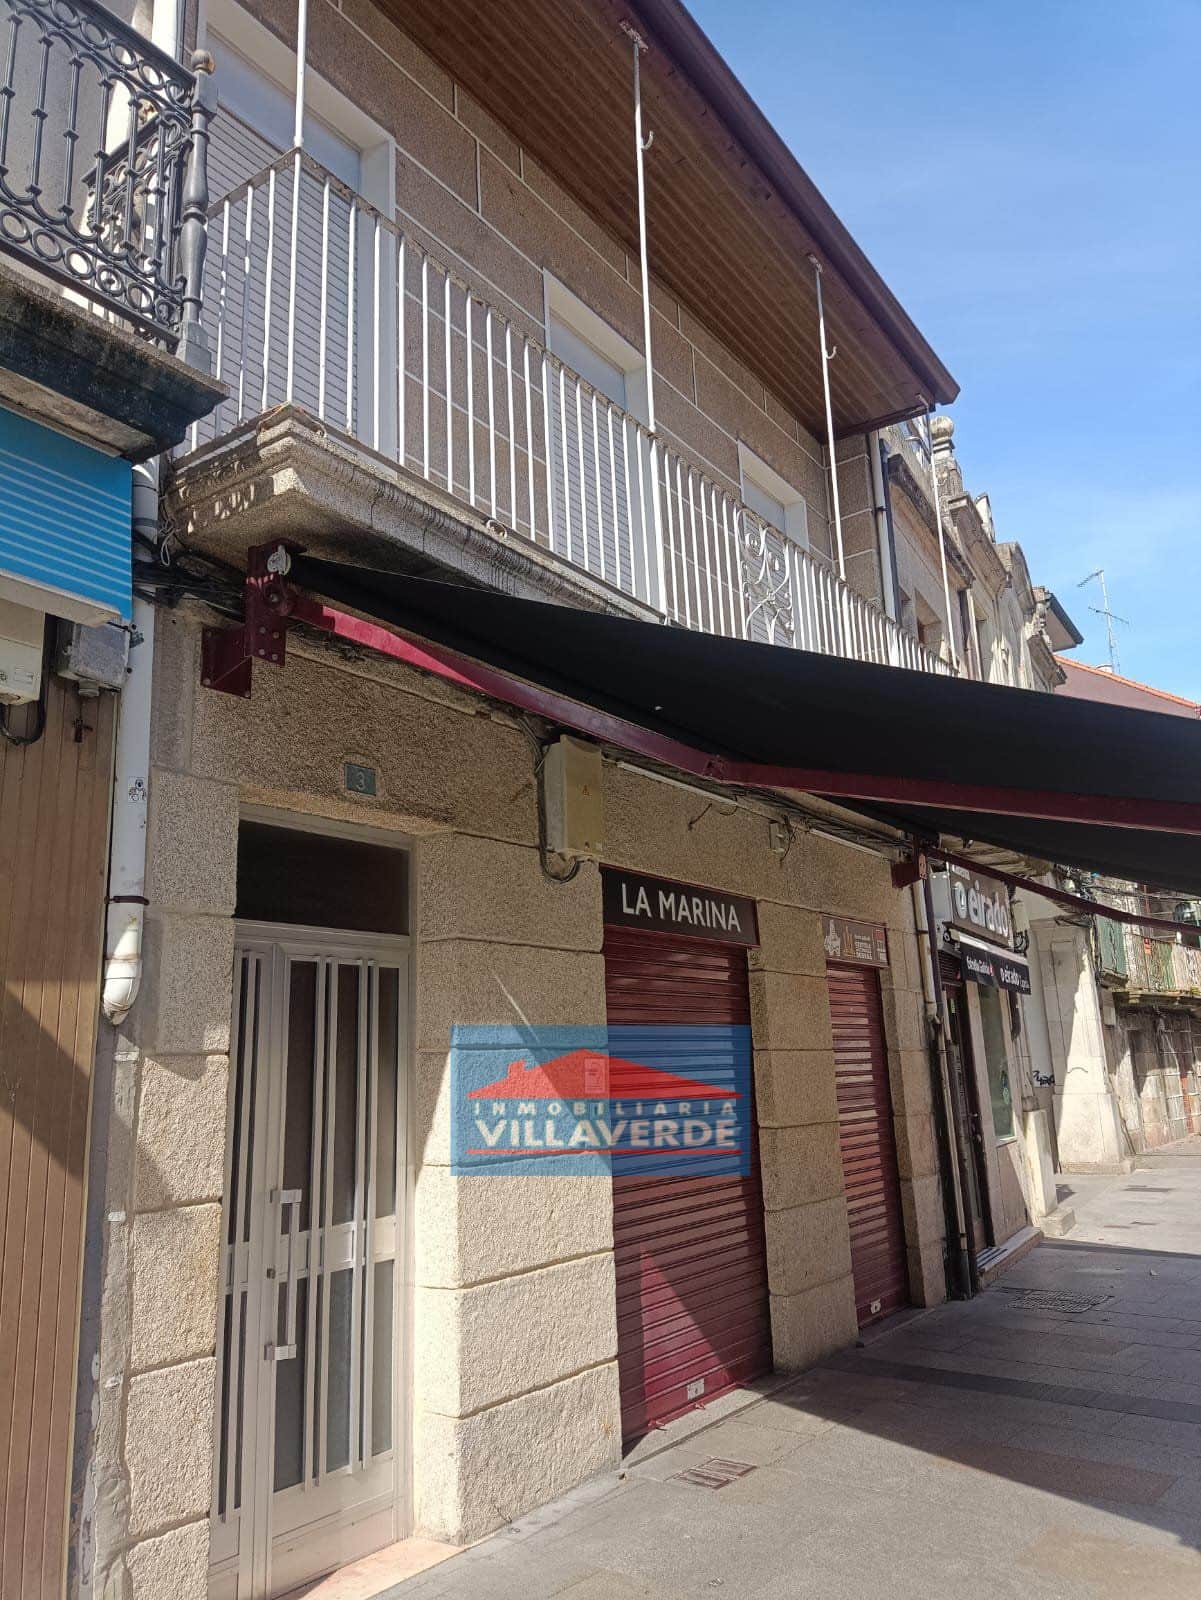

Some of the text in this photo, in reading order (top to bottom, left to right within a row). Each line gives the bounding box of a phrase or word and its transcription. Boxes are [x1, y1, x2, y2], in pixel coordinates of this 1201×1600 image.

[355, 770, 367, 791] 3
[621, 882, 741, 933] LA MARINA
